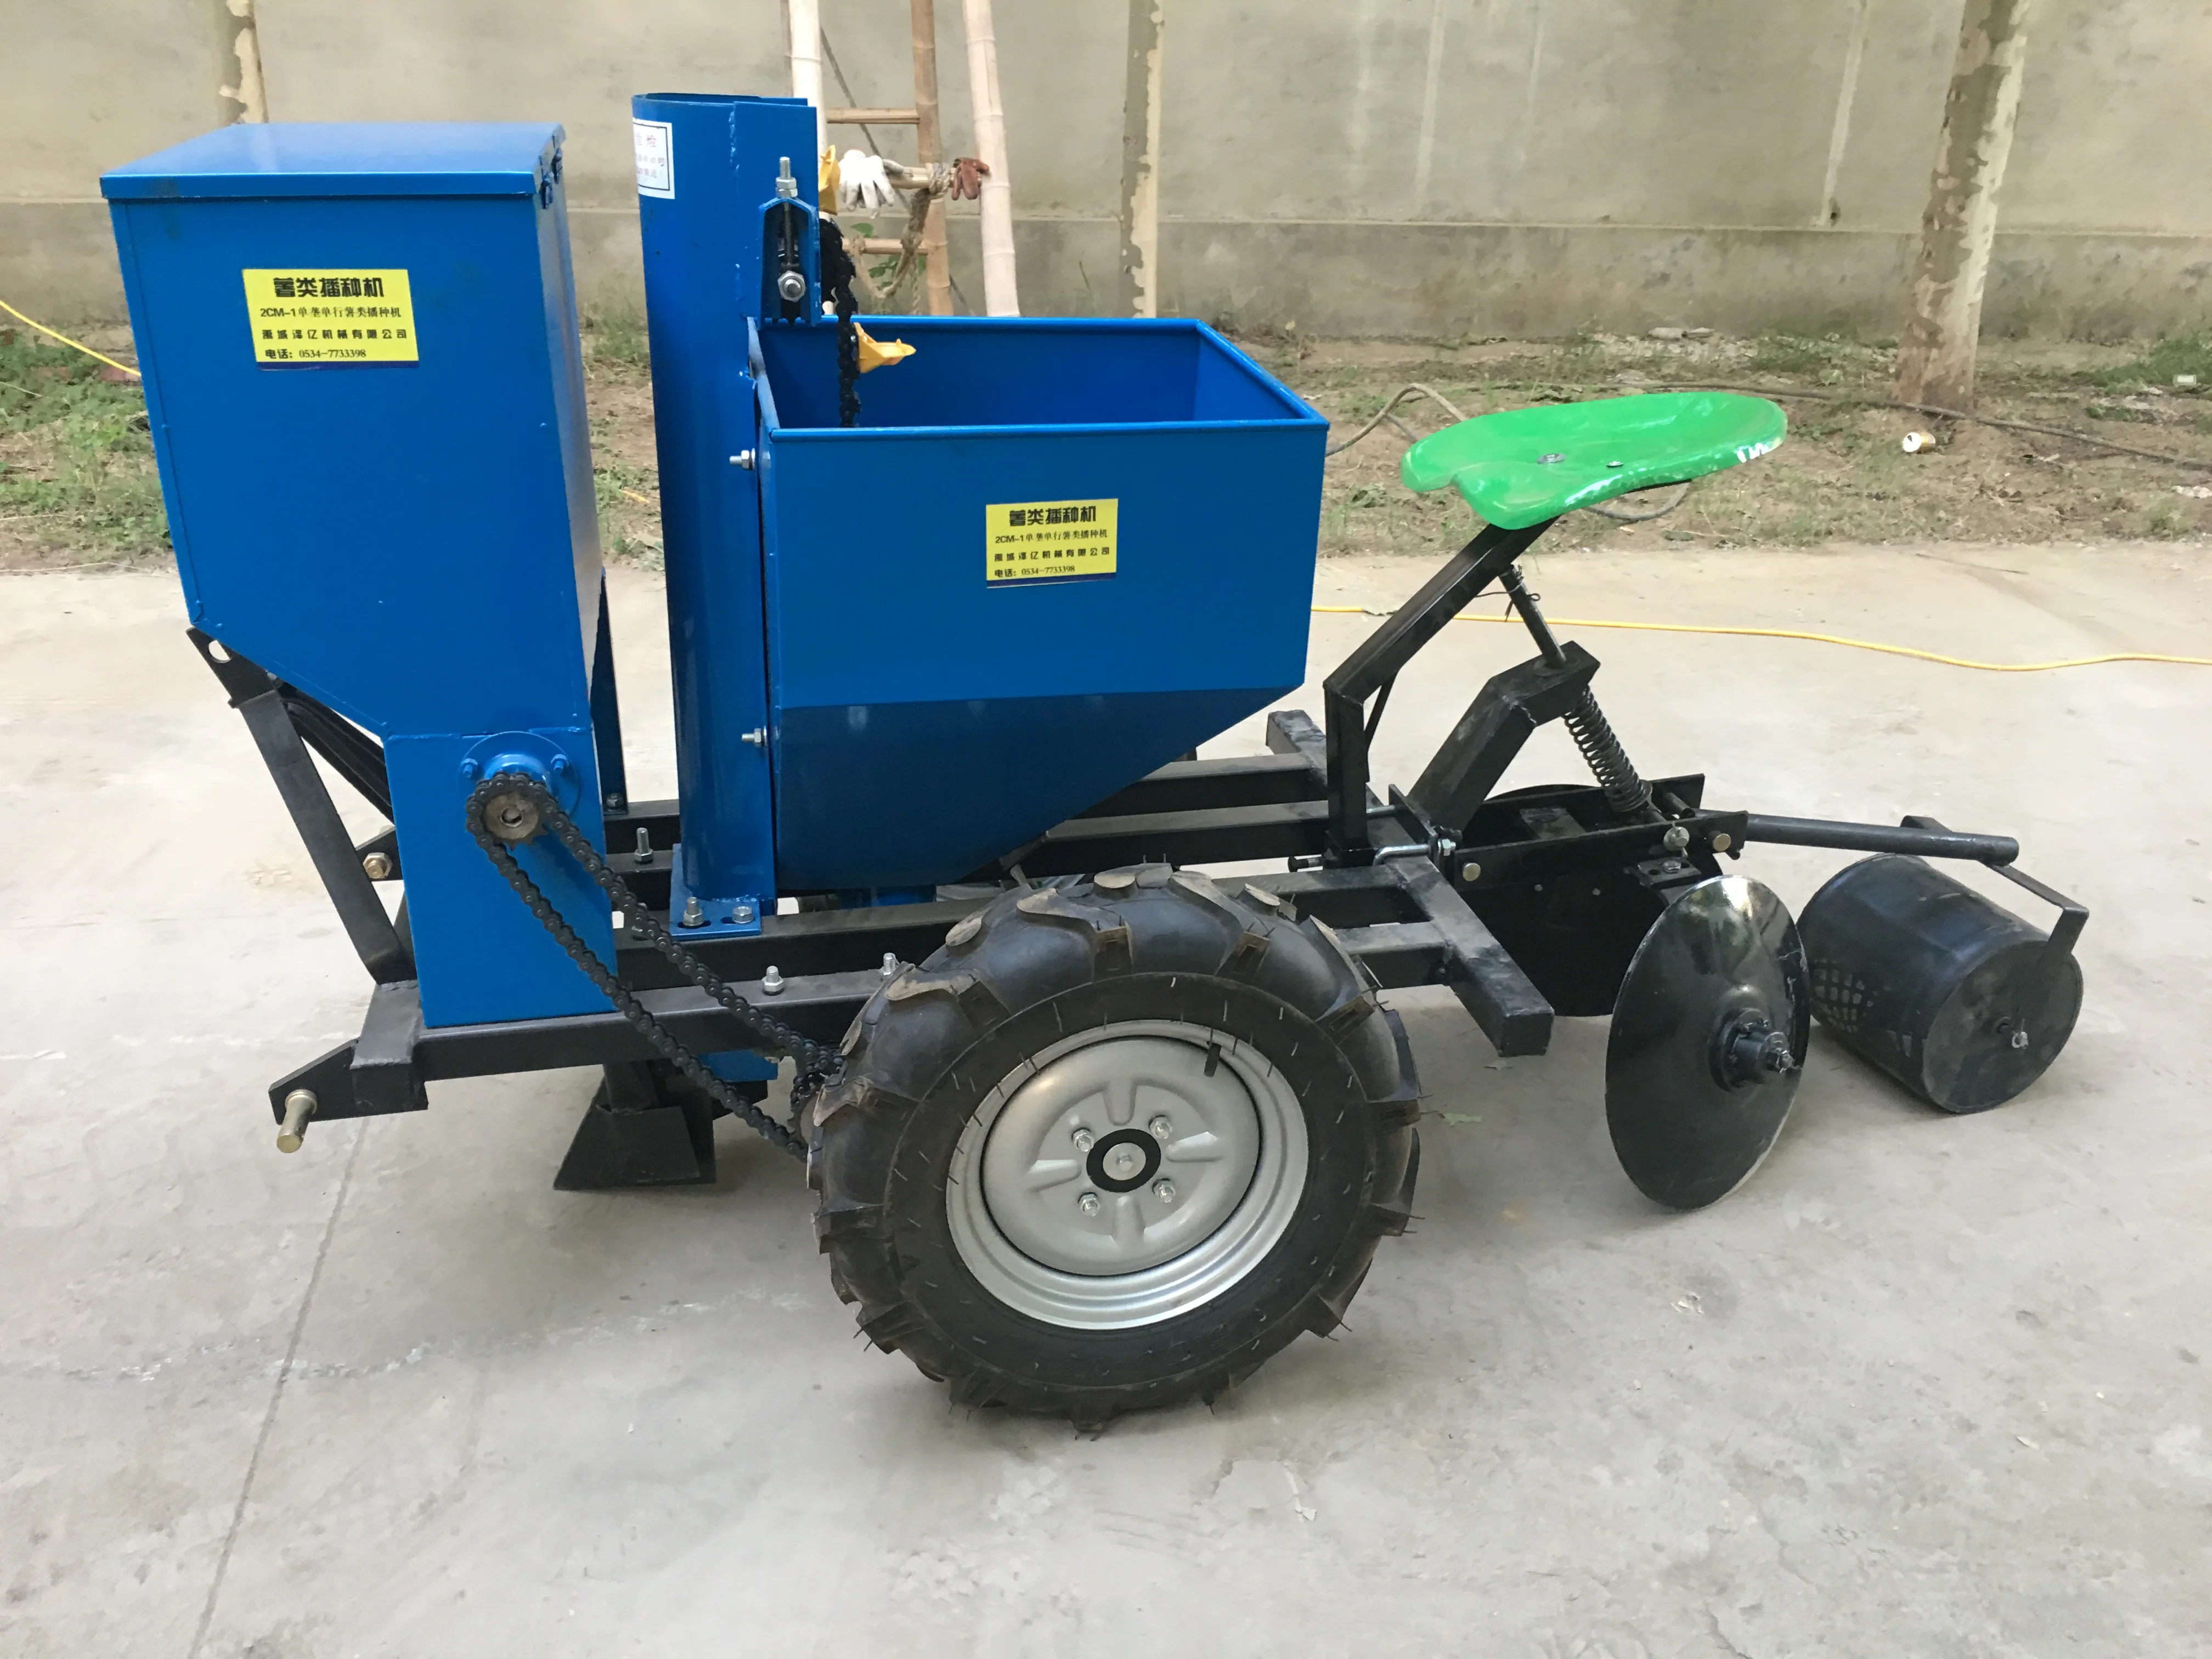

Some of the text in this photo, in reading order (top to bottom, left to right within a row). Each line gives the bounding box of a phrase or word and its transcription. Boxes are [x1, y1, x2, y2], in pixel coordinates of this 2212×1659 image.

[273, 278, 384, 297] 薯类播种机
[1009, 506, 1096, 527] 薯类播种机
